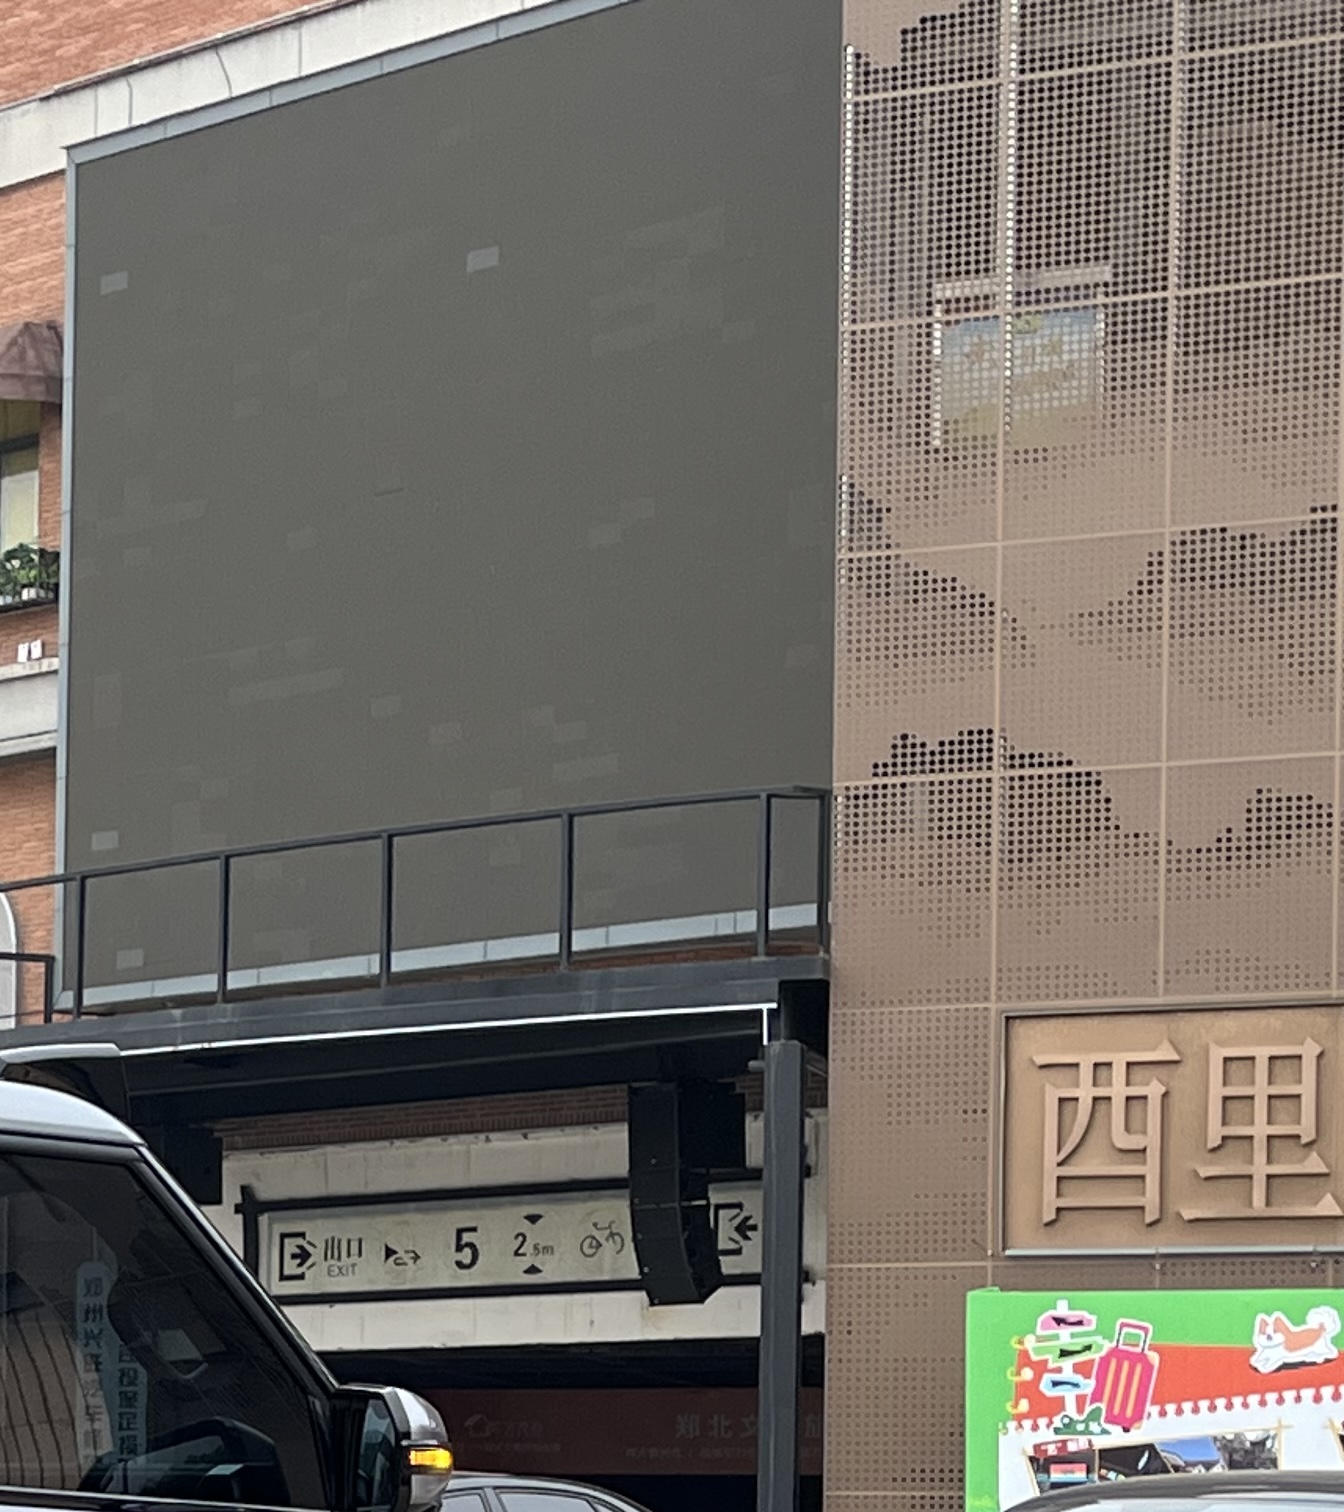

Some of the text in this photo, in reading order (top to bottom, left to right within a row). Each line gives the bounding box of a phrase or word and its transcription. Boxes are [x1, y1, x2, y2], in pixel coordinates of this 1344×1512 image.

[324, 1236, 363, 1262] 出口
[454, 1226, 480, 1270] 5
[326, 1263, 358, 1278] EXIT
